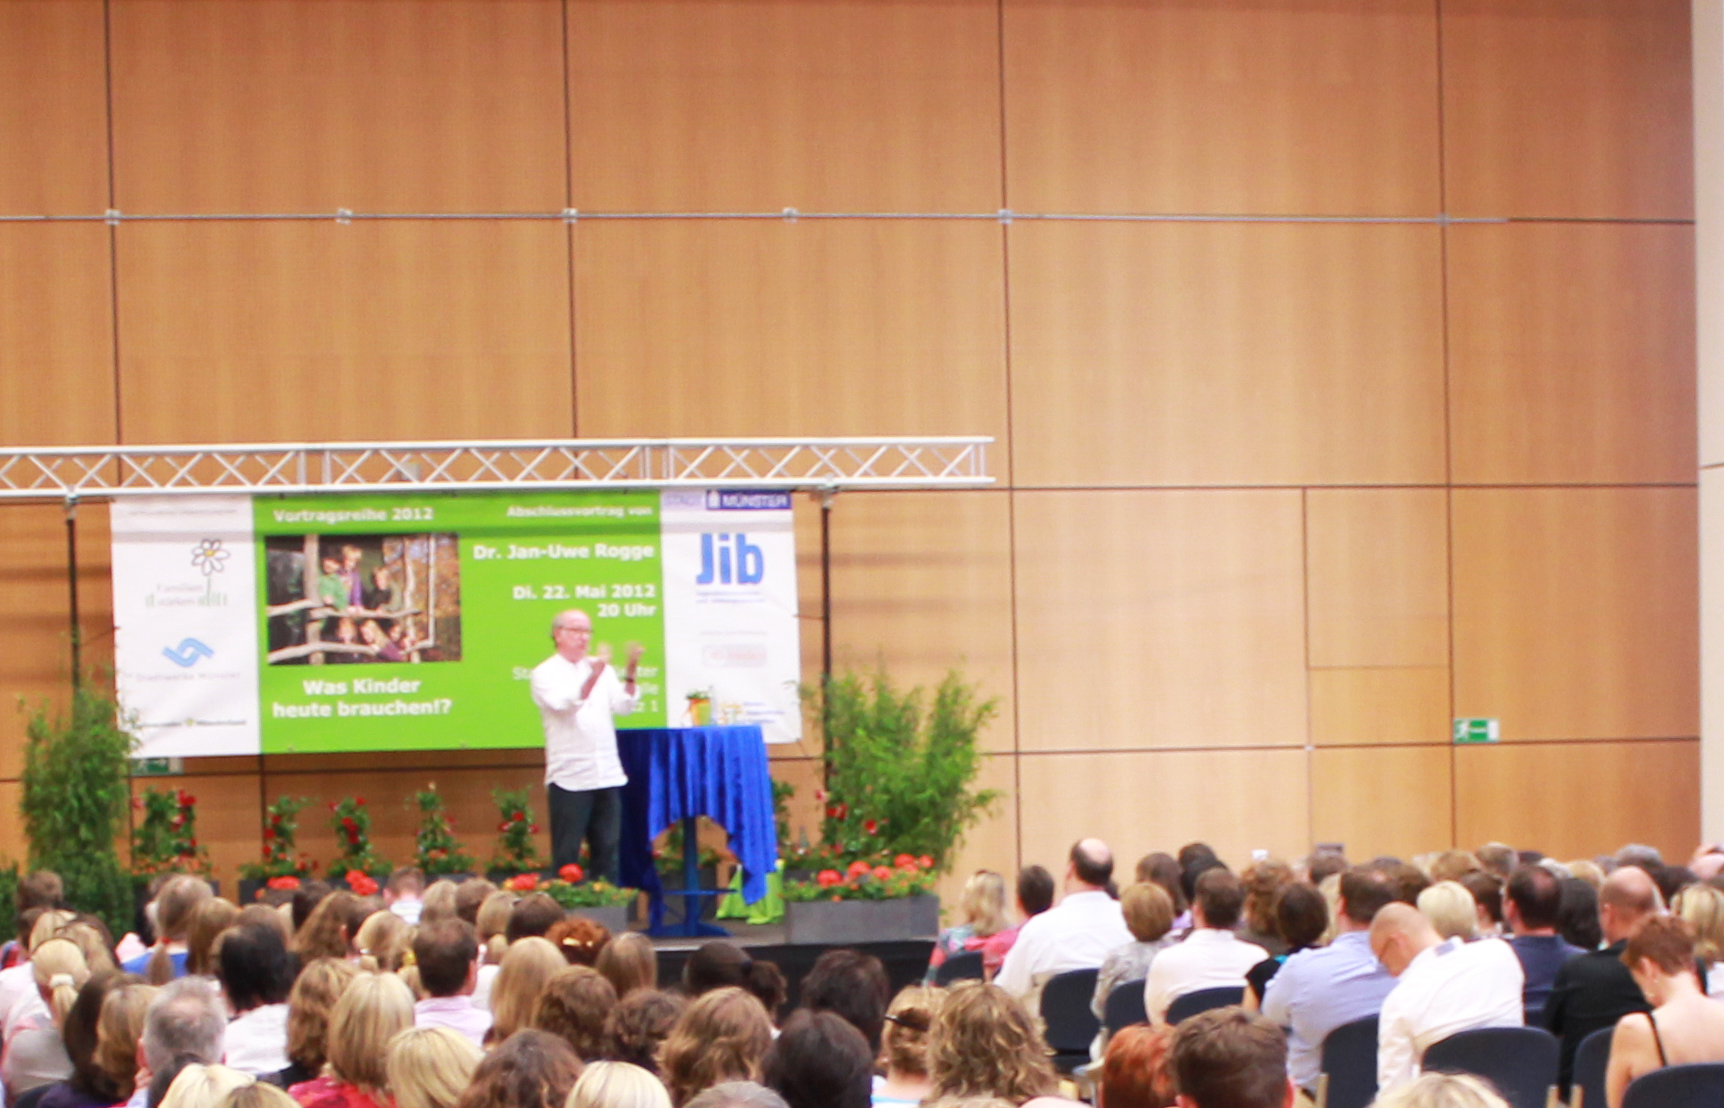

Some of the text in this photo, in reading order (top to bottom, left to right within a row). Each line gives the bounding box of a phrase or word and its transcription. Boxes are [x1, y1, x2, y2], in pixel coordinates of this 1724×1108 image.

[722, 493, 788, 507] MÜNSTER
[273, 507, 434, 524] Vortragsreihe 2012
[506, 506, 653, 518] Abschlussvortrag von
[473, 543, 655, 561] Dr. Jan-Uwe Rogge
[696, 533, 764, 585] Jib
[512, 583, 656, 600] Di. 22. Mai 2012
[597, 603, 657, 618] 20 Uhr
[302, 677, 422, 696] Was Kinder
[272, 698, 453, 718] heute brauchen!?
